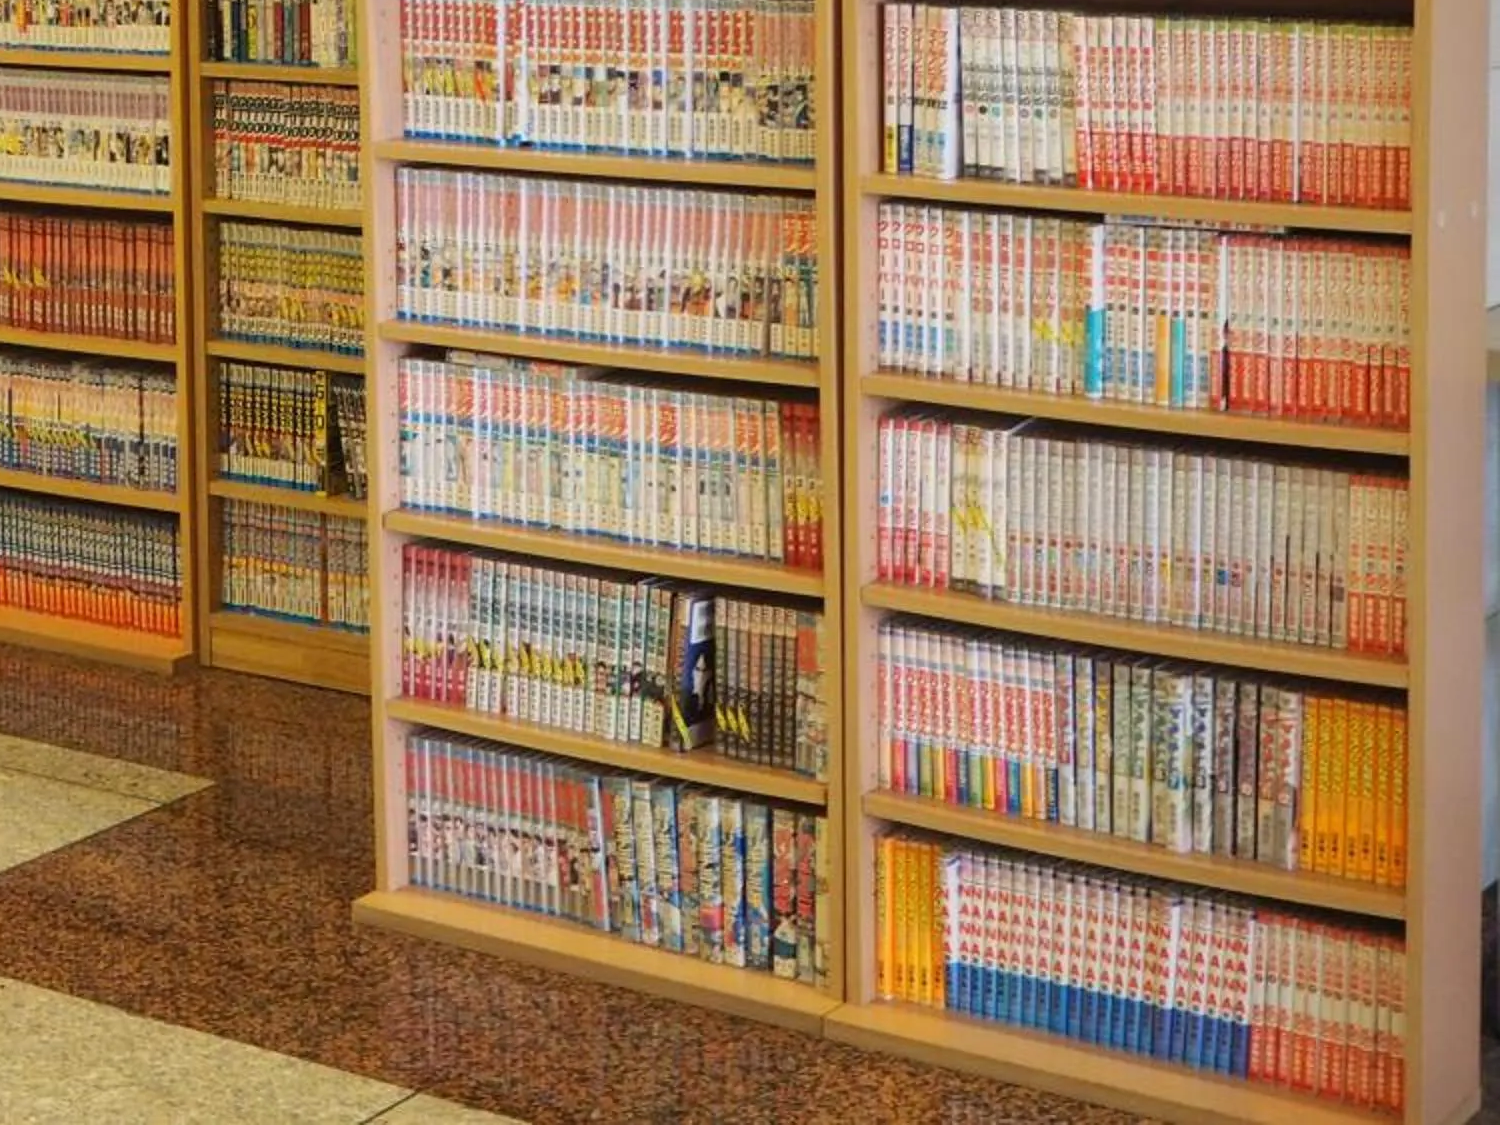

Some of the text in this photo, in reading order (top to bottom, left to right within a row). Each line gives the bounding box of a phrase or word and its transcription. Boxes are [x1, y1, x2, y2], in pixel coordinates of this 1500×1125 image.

[961, 885, 971, 954] NANA
[972, 887, 981, 955] NANA
[985, 889, 995, 963] NANA
[998, 891, 1009, 960] NANA
[1011, 892, 1022, 963] NANA
[1024, 895, 1035, 965] NANA
[1038, 897, 1050, 968] NANA
[1053, 902, 1065, 974] NANA
[1070, 905, 1082, 975] NANA
[1086, 909, 1096, 981] NANA
[1100, 912, 1113, 982] NANA
[1115, 916, 1126, 986] NANA
[1130, 919, 1142, 988] NANA
[1145, 922, 1159, 991] NANA
[1159, 926, 1170, 996] NANA
[1176, 929, 1192, 998] NANA
[1191, 932, 1207, 1004] NANA
[1207, 935, 1221, 1007] NANA
[1223, 938, 1235, 1009] NANA
[1234, 940, 1249, 1013] NANA
